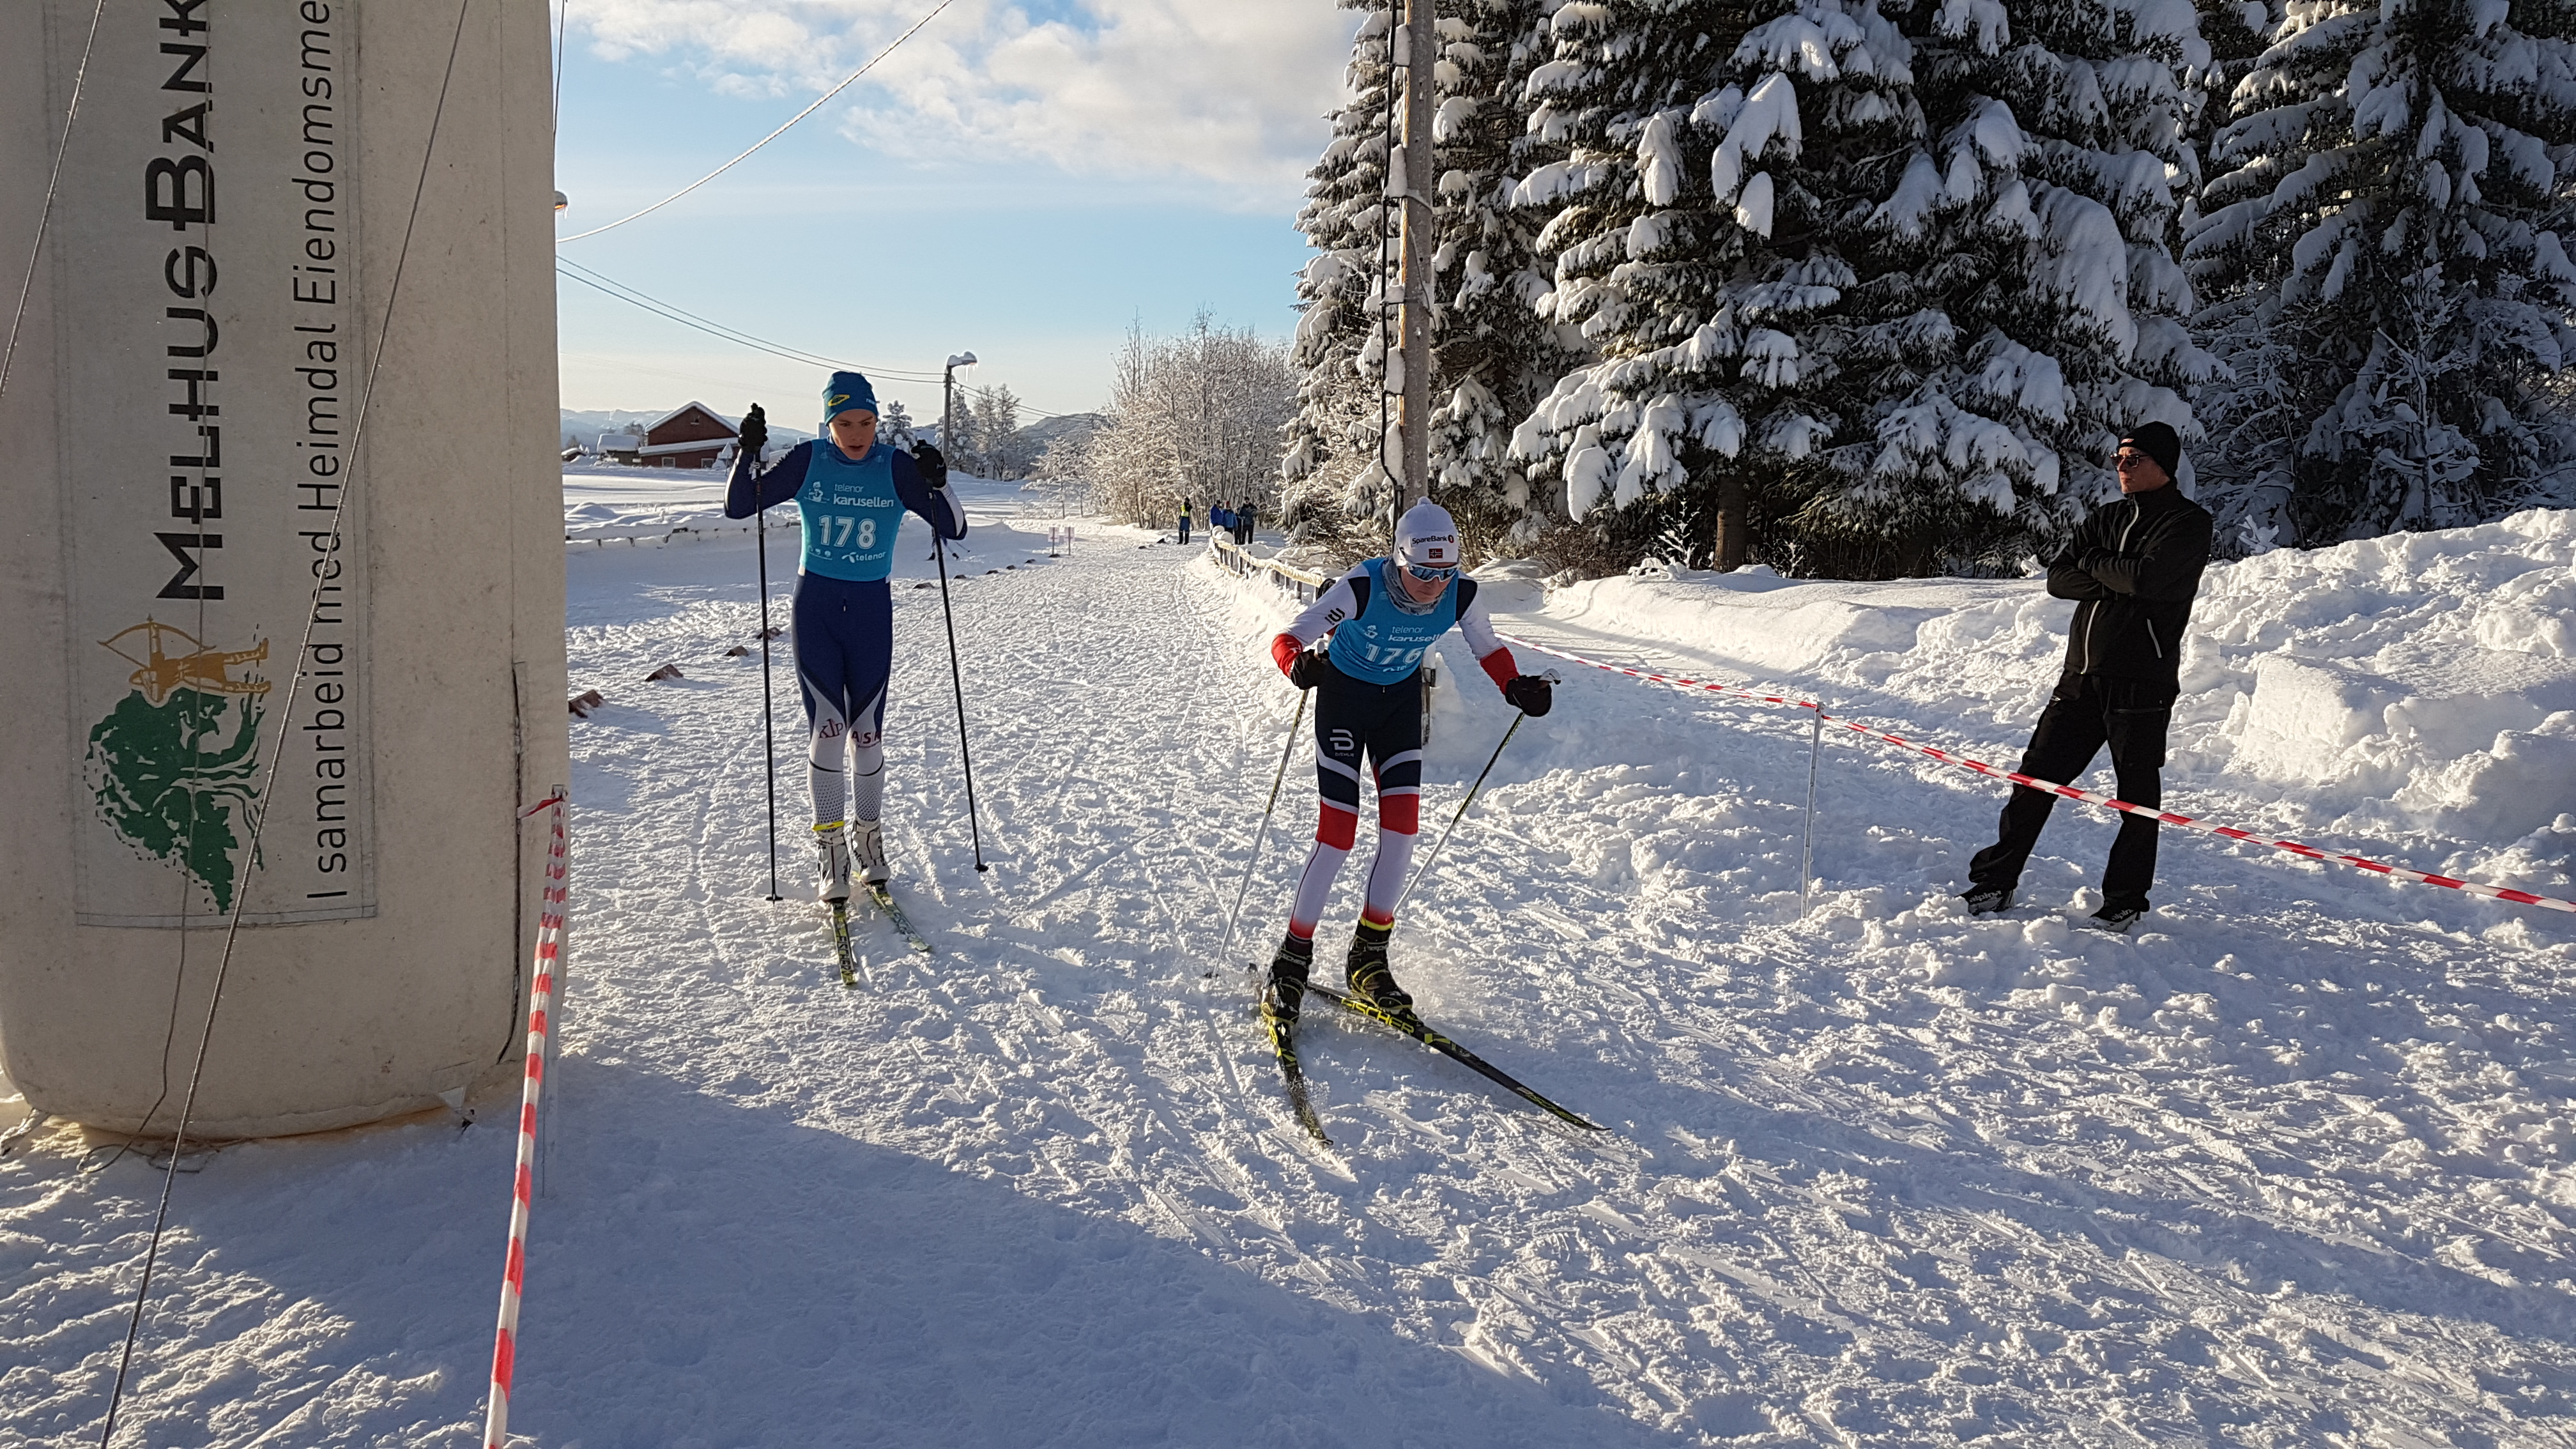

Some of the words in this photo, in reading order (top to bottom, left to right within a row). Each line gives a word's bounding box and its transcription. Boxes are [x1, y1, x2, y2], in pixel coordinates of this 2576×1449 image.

[291, 0, 336, 305] Eiendomsme
[294, 323, 340, 511] Heimdal
[833, 494, 894, 507] karusellen
[834, 484, 864, 493] telenor
[819, 515, 876, 549] 178
[1412, 535, 1448, 544] SpareBank
[856, 551, 886, 561] telenor
[298, 532, 342, 624] med
[301, 644, 347, 874] samarbeid
